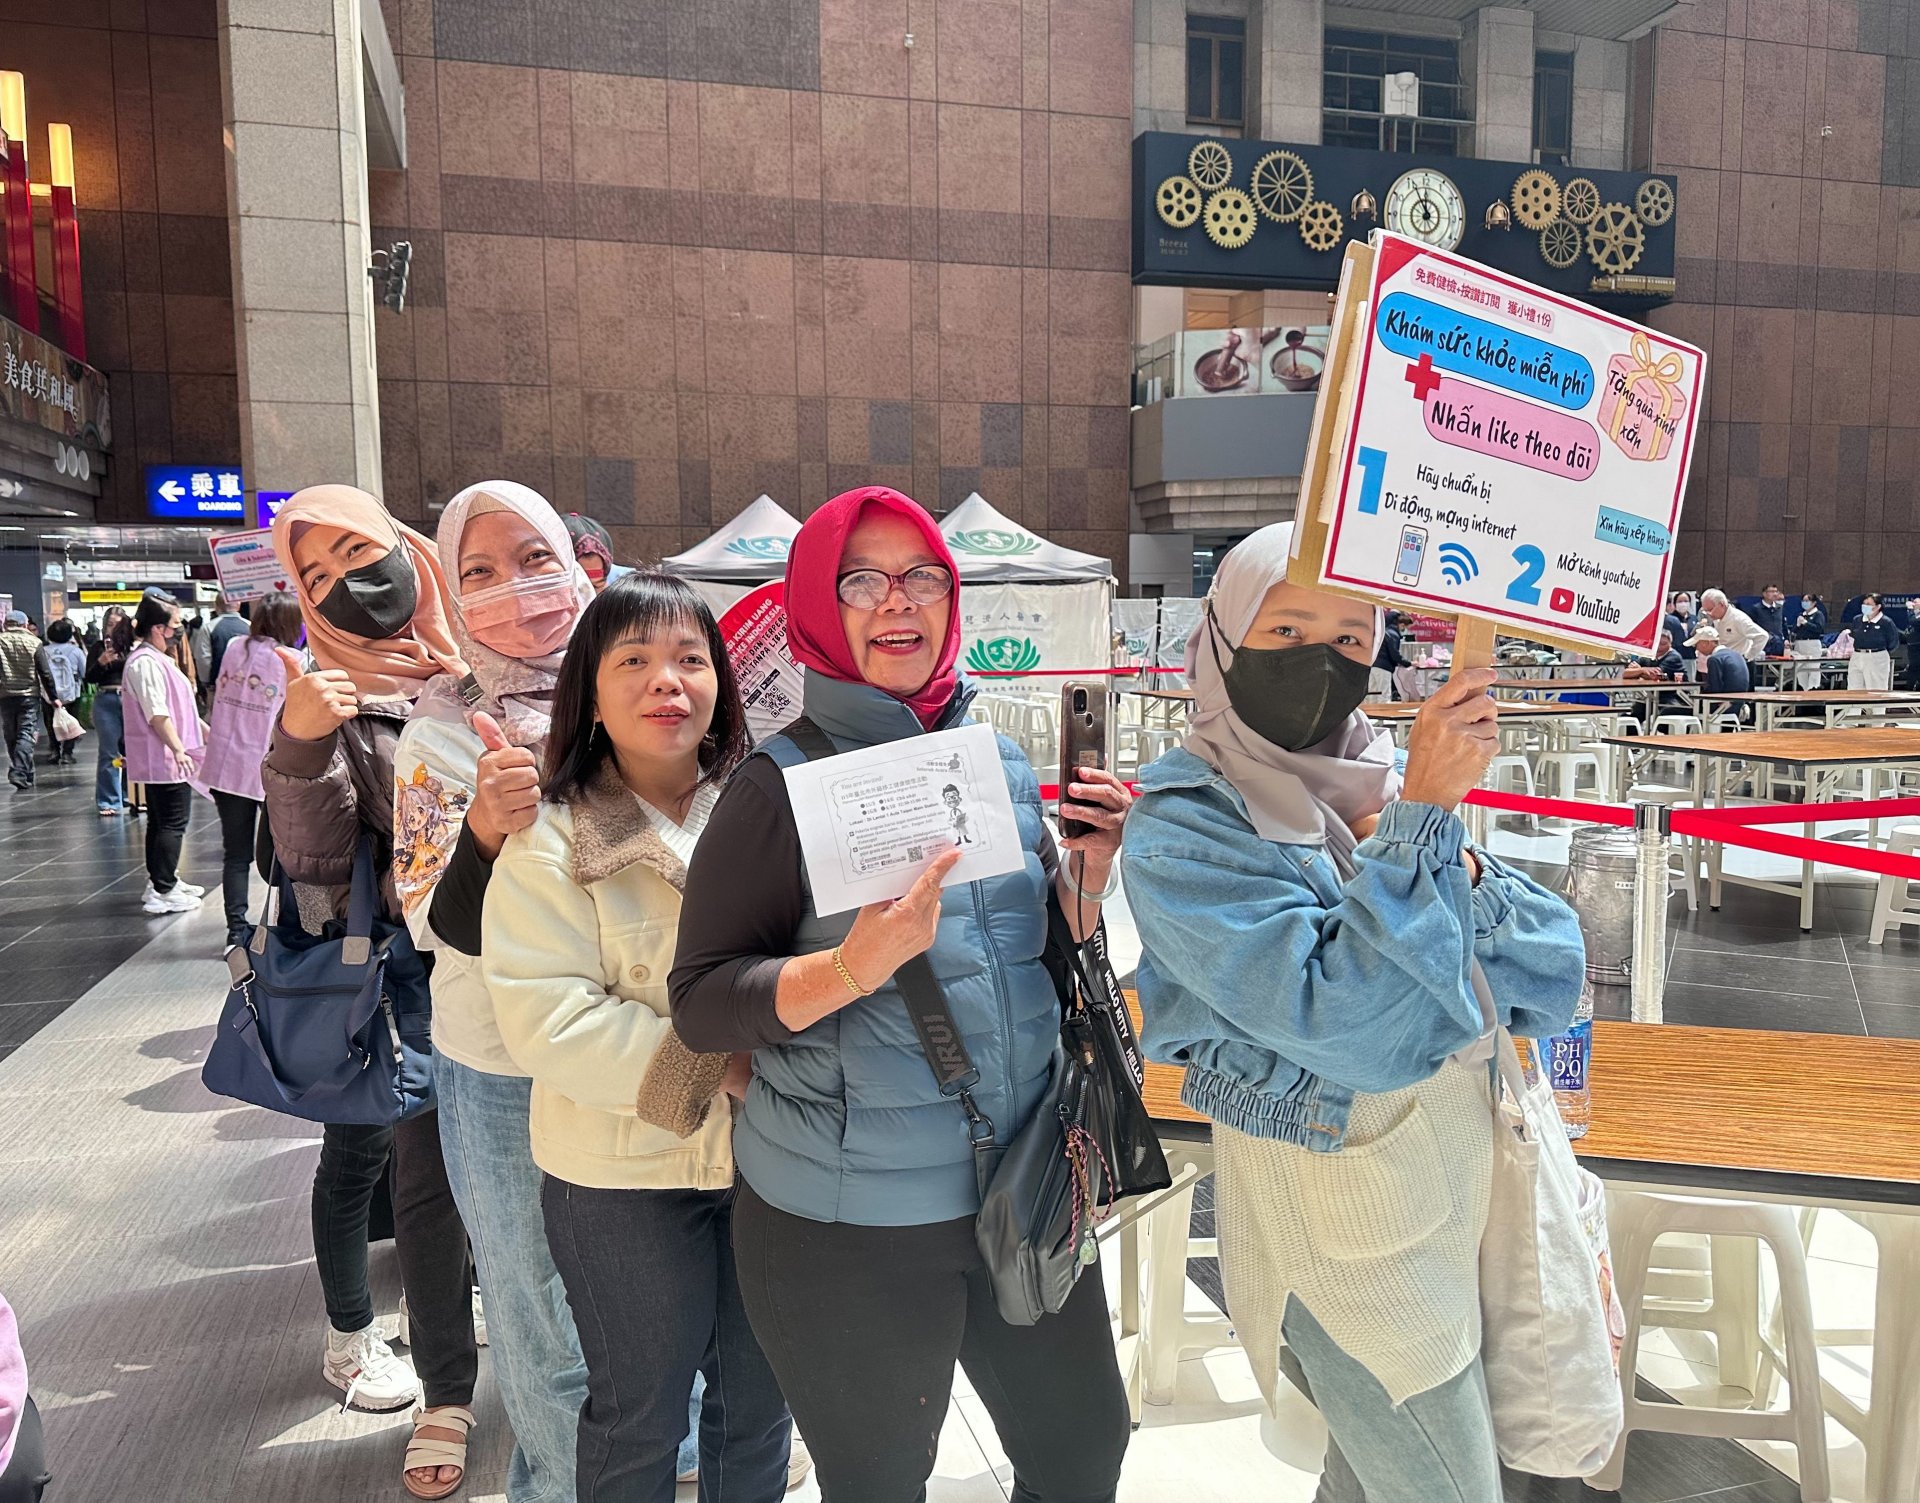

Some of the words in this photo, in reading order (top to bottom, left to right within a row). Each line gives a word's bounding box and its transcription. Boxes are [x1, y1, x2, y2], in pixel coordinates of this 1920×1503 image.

[1385, 308, 1433, 345] Khám
[1437, 325, 1471, 358] sức
[1476, 336, 1516, 373] khỏe
[1520, 351, 1558, 388] miễn
[1561, 369, 1589, 399] phí
[1608, 369, 1635, 407] Tặng
[1635, 398, 1654, 420] quà
[1653, 413, 1676, 438] xinh
[1431, 400, 1481, 439] Nhấn
[1487, 416, 1519, 449] like
[1525, 430, 1561, 461] theo
[1566, 441, 1593, 471] dõi
[191, 473, 242, 498] 乘車
[1357, 445, 1388, 515] 1
[1416, 463, 1440, 491] Hãy
[1442, 472, 1478, 497] chuẩn
[1480, 480, 1493, 504] bị
[1384, 491, 1399, 511] Di
[1400, 495, 1433, 523] động,
[1436, 509, 1469, 533] mạng
[1471, 514, 1518, 541] internet
[1599, 515, 1614, 532] Xin
[1614, 519, 1630, 541] hãy
[1630, 525, 1646, 545] xếp
[1646, 528, 1665, 551] hàng
[1505, 543, 1546, 606] 2
[1556, 552, 1579, 572] Mở
[1578, 559, 1602, 582] kênh
[1602, 570, 1641, 590] youtube
[733, 619, 754, 644] KIRIM
[752, 598, 773, 620] UANG
[736, 643, 748, 655] KE
[745, 604, 783, 645] INDONESIA
[1575, 593, 1620, 624] YouTube
[750, 640, 764, 657] DAN
[762, 613, 788, 641] TERPERC
[736, 667, 751, 686] ESMI
[749, 647, 771, 670] TANPA
[1093, 931, 1106, 961] KITTY
[1104, 969, 1119, 1008] HELLO
[1114, 1006, 1130, 1039] KITTY
[1125, 1046, 1143, 1084] HELLO
[1553, 1060, 1581, 1078] 9.0
[1554, 1042, 1581, 1059] PH
